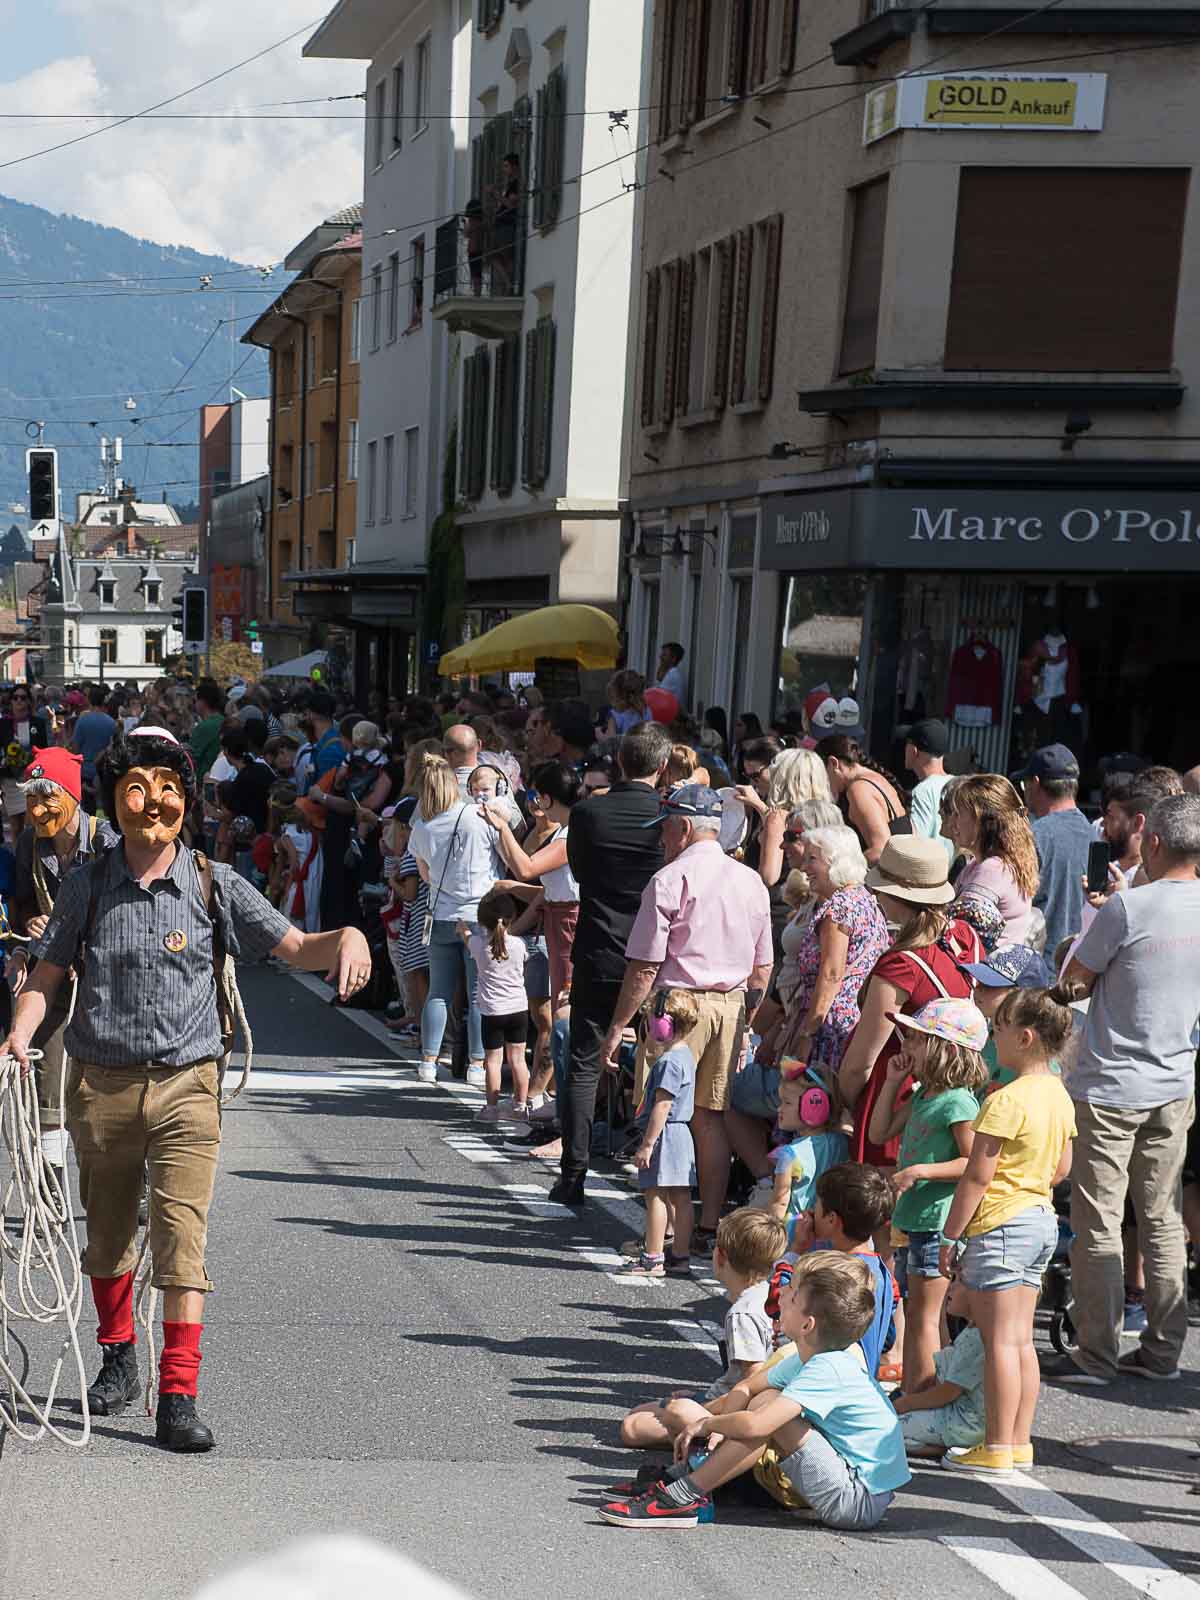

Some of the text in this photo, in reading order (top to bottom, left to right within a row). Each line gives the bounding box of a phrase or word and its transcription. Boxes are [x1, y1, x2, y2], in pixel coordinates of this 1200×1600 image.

[939, 85, 1072, 116] GOLD Ankauf
[908, 506, 1200, 543] Marc O'Pol
[430, 642, 439, 657] P
